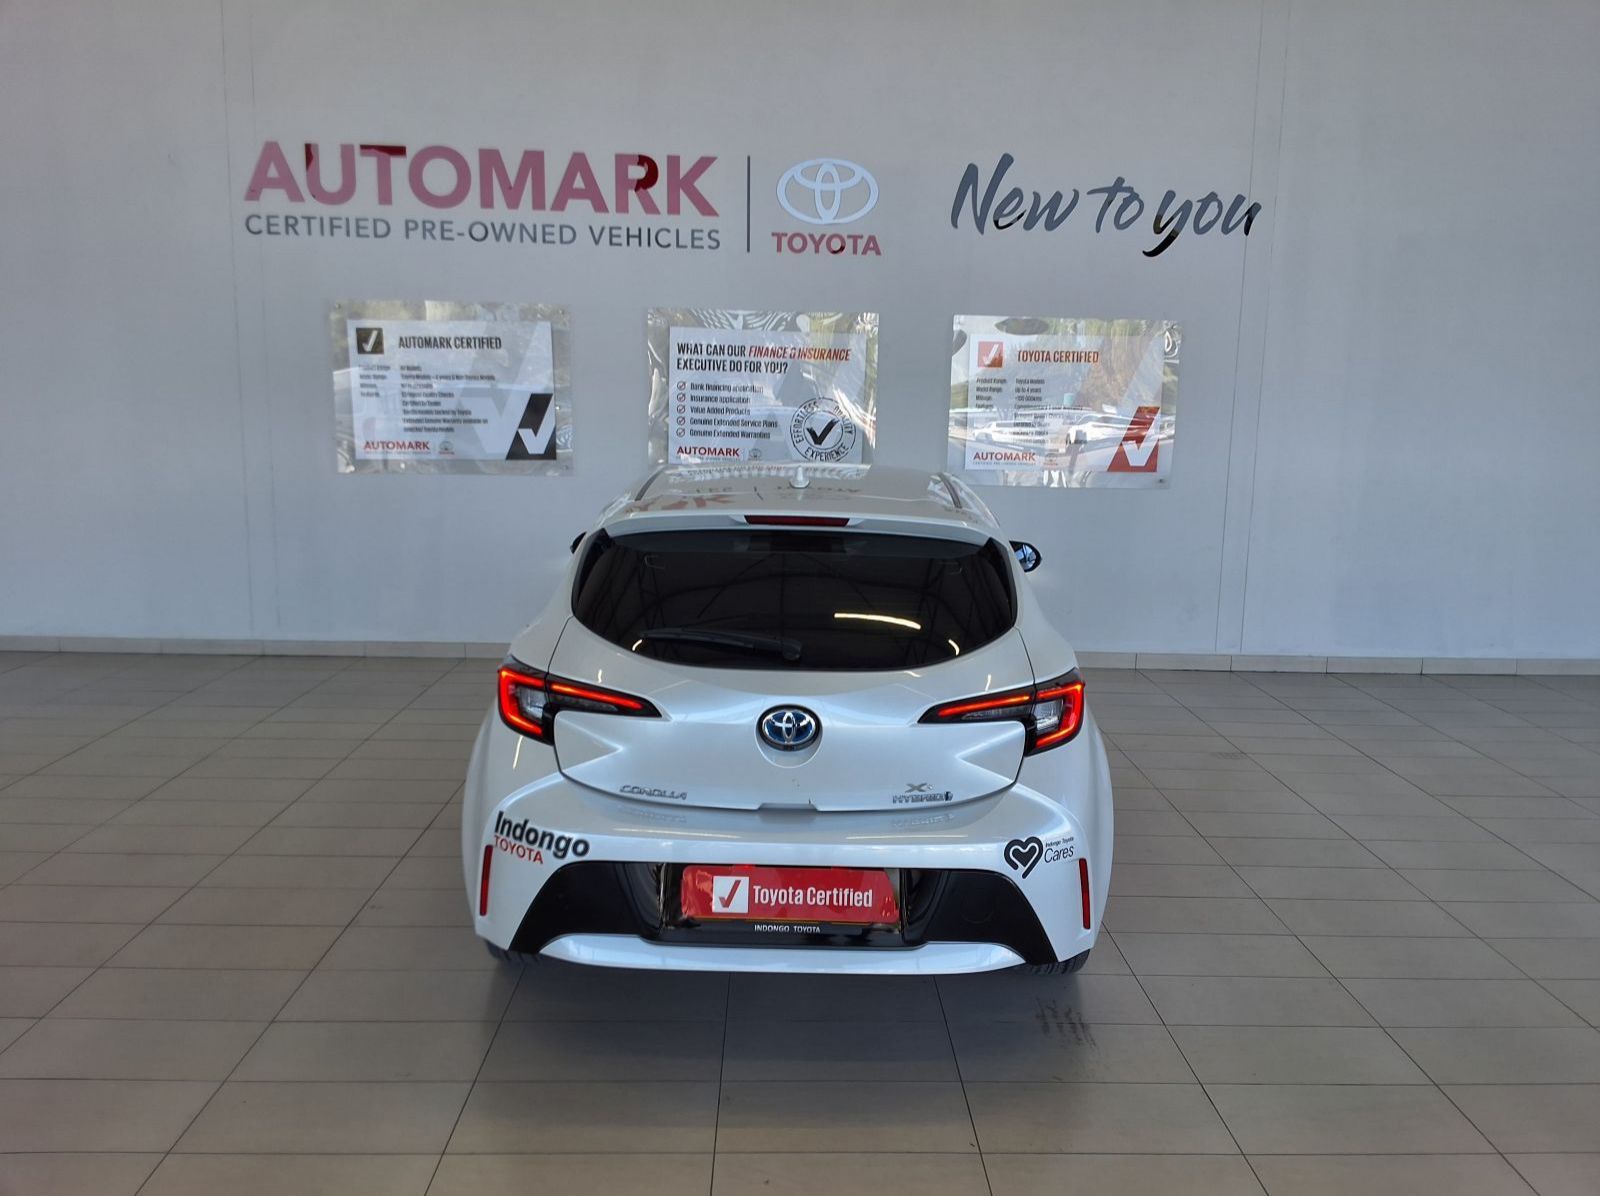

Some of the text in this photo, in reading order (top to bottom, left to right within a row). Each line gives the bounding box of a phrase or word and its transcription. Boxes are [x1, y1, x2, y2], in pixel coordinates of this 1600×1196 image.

[243, 141, 720, 217] AUTOMARK
[950, 153, 1262, 258] New to you
[245, 214, 721, 249] CERTIFIED PRE-OWNED VEHICLES
[771, 231, 882, 257] TOYOTA
[399, 336, 502, 349] AUTOMARK CERTIFIED
[677, 342, 703, 356] WHAT
[706, 344, 725, 356] CAN
[727, 345, 746, 357] OUR
[748, 345, 789, 359] FINANCE
[797, 347, 852, 361] INSURANCE
[1017, 350, 1099, 363] TOYOTA CERTIFIED
[677, 358, 788, 374] EXECUTIVE DO FOR YOU?
[690, 382, 704, 391] Bank
[705, 383, 731, 393] financing
[690, 394, 750, 404] Insurance application
[690, 406, 750, 415] Value Added Products
[690, 417, 778, 428] Genuine Extended Service Plans
[690, 429, 712, 437] Genuine
[713, 429, 740, 438] Extended
[364, 440, 430, 450] AUTOMARK
[677, 446, 740, 456] AUTOMARK
[973, 451, 1035, 461] AUTOMARK
[494, 810, 590, 859] Indongo
[494, 834, 543, 864] TOYOTA
[1044, 845, 1074, 863] Cares
[753, 885, 873, 907] Toyota Certified
[754, 924, 821, 933] INDONGO TOYOTA
